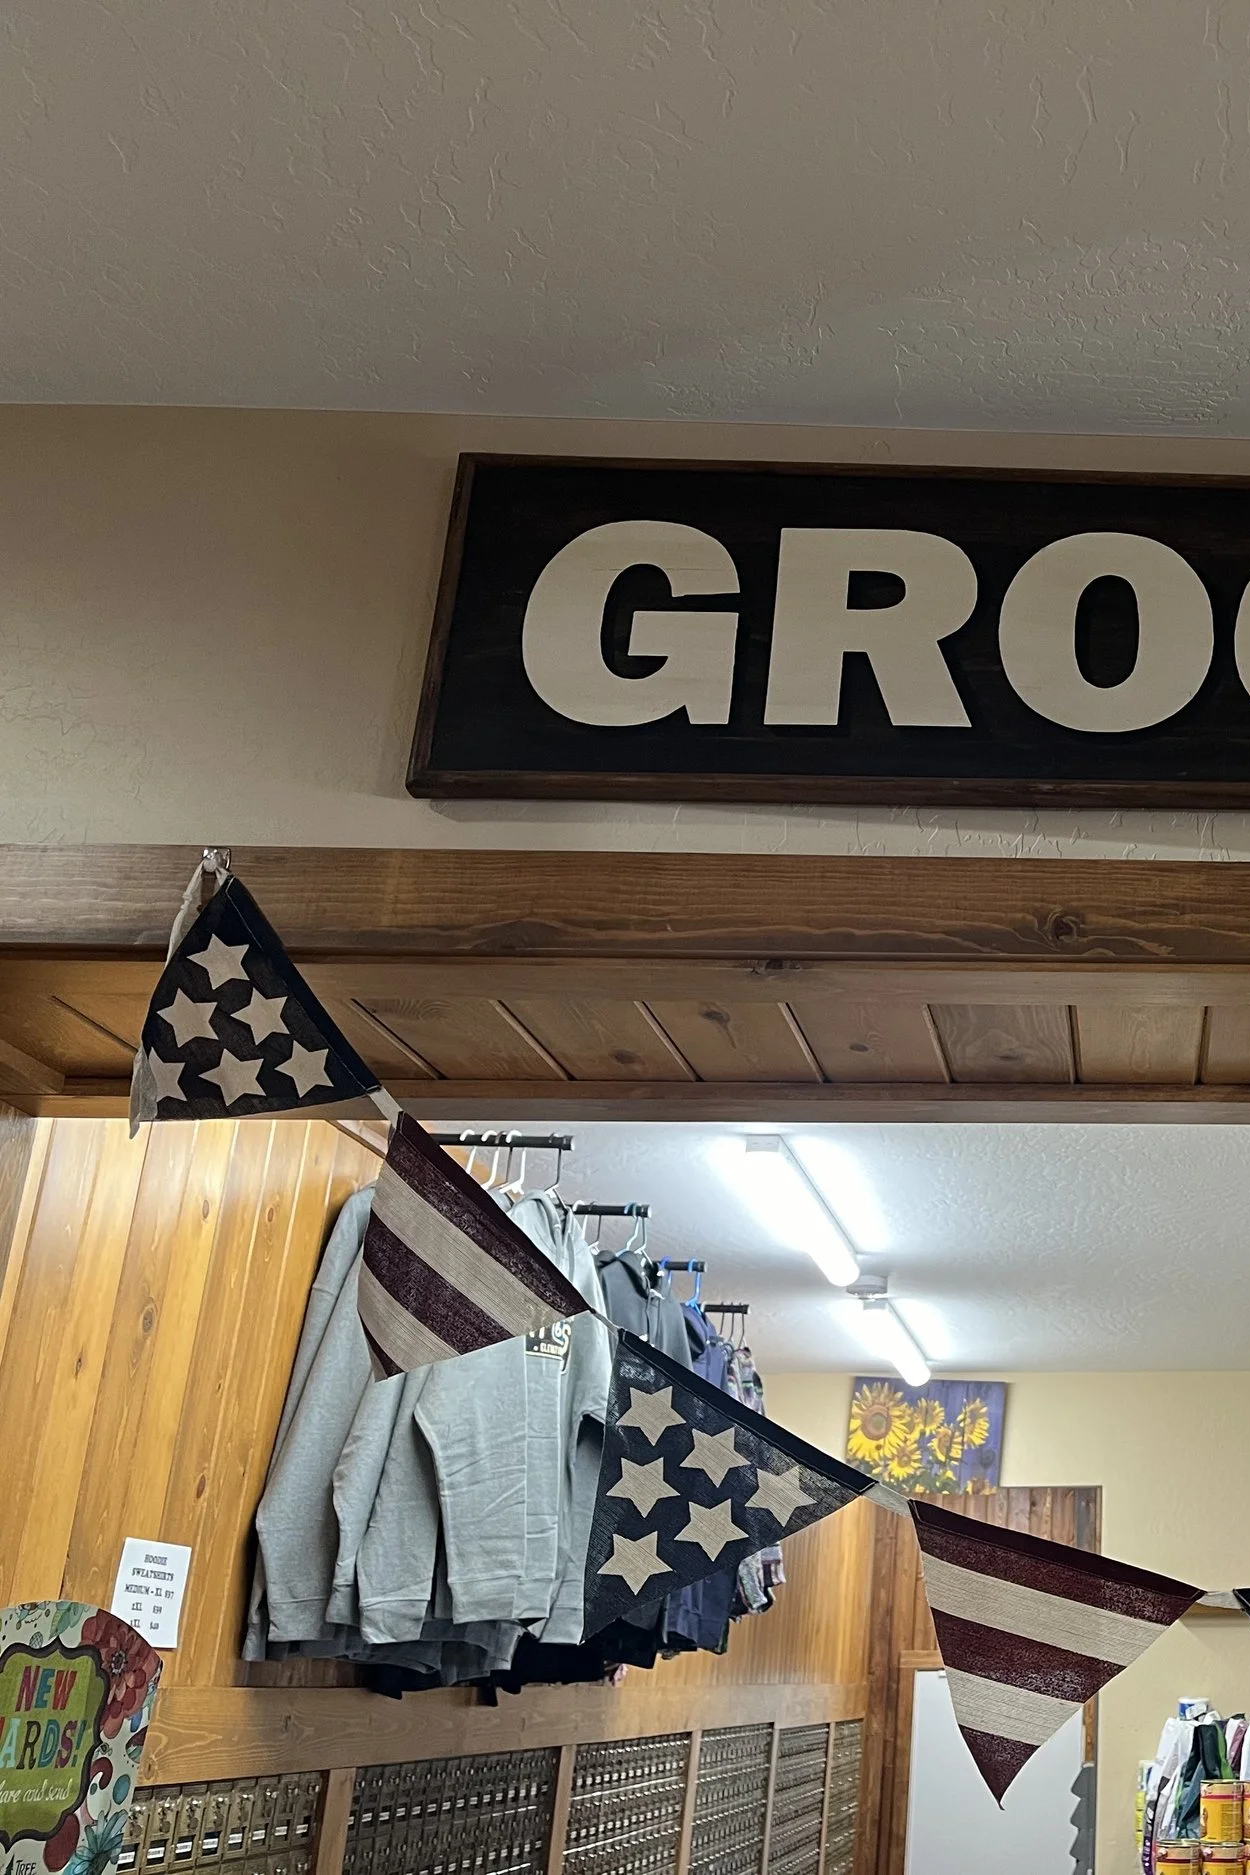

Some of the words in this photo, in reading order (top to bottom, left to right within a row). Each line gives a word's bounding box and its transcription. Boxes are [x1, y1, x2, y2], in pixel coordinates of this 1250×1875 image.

[132, 1568, 174, 1582] SWEATSHIRTS
[15, 1665, 77, 1712] NEW
[0, 1716, 87, 1770] ARDS!
